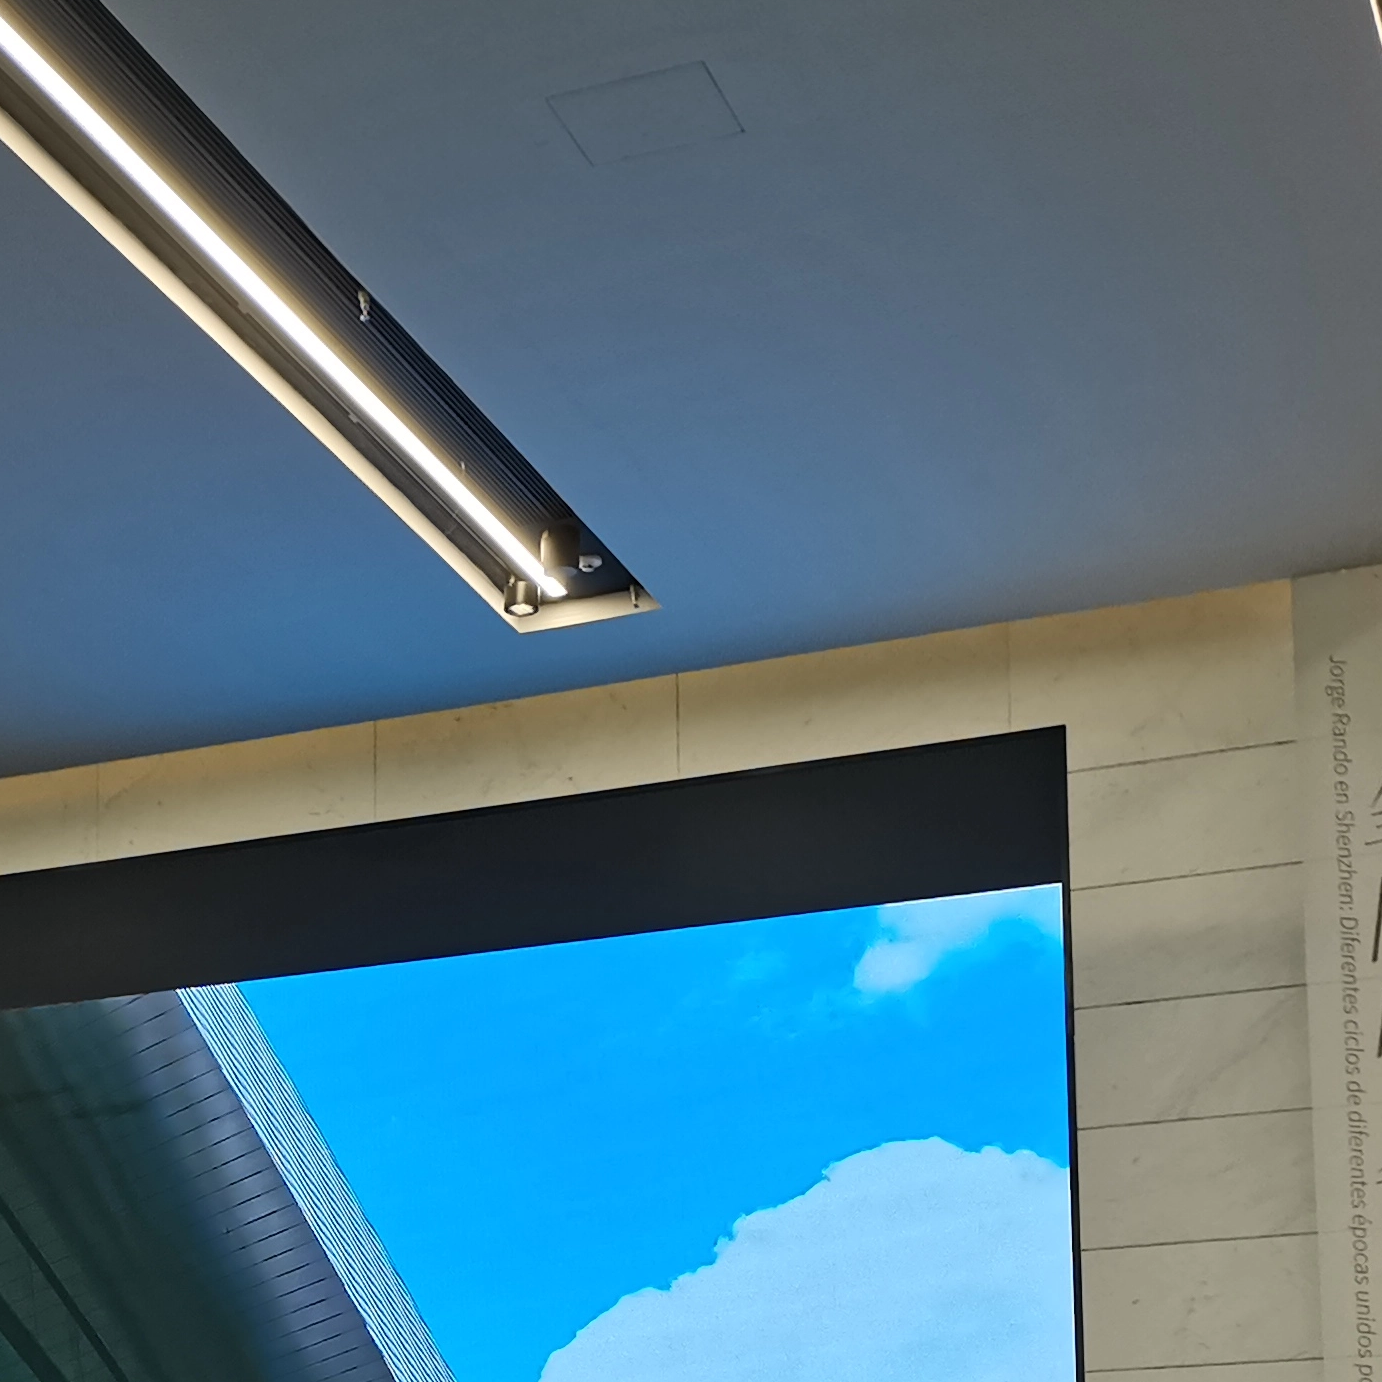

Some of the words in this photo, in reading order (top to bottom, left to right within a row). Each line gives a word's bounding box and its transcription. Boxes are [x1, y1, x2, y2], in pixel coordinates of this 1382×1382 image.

[1324, 654, 1347, 709] Jorge
[1331, 712, 1353, 776] Rando
[1333, 780, 1350, 804] en
[1334, 809, 1358, 911] Shenzhen:
[1338, 915, 1362, 1015] Diferentes
[1343, 1018, 1365, 1076] ciclos
[1345, 1080, 1367, 1106] de
[1347, 1109, 1369, 1209] diferentes
[1348, 1213, 1373, 1286] épocas
[1354, 1290, 1377, 1359] unidos
